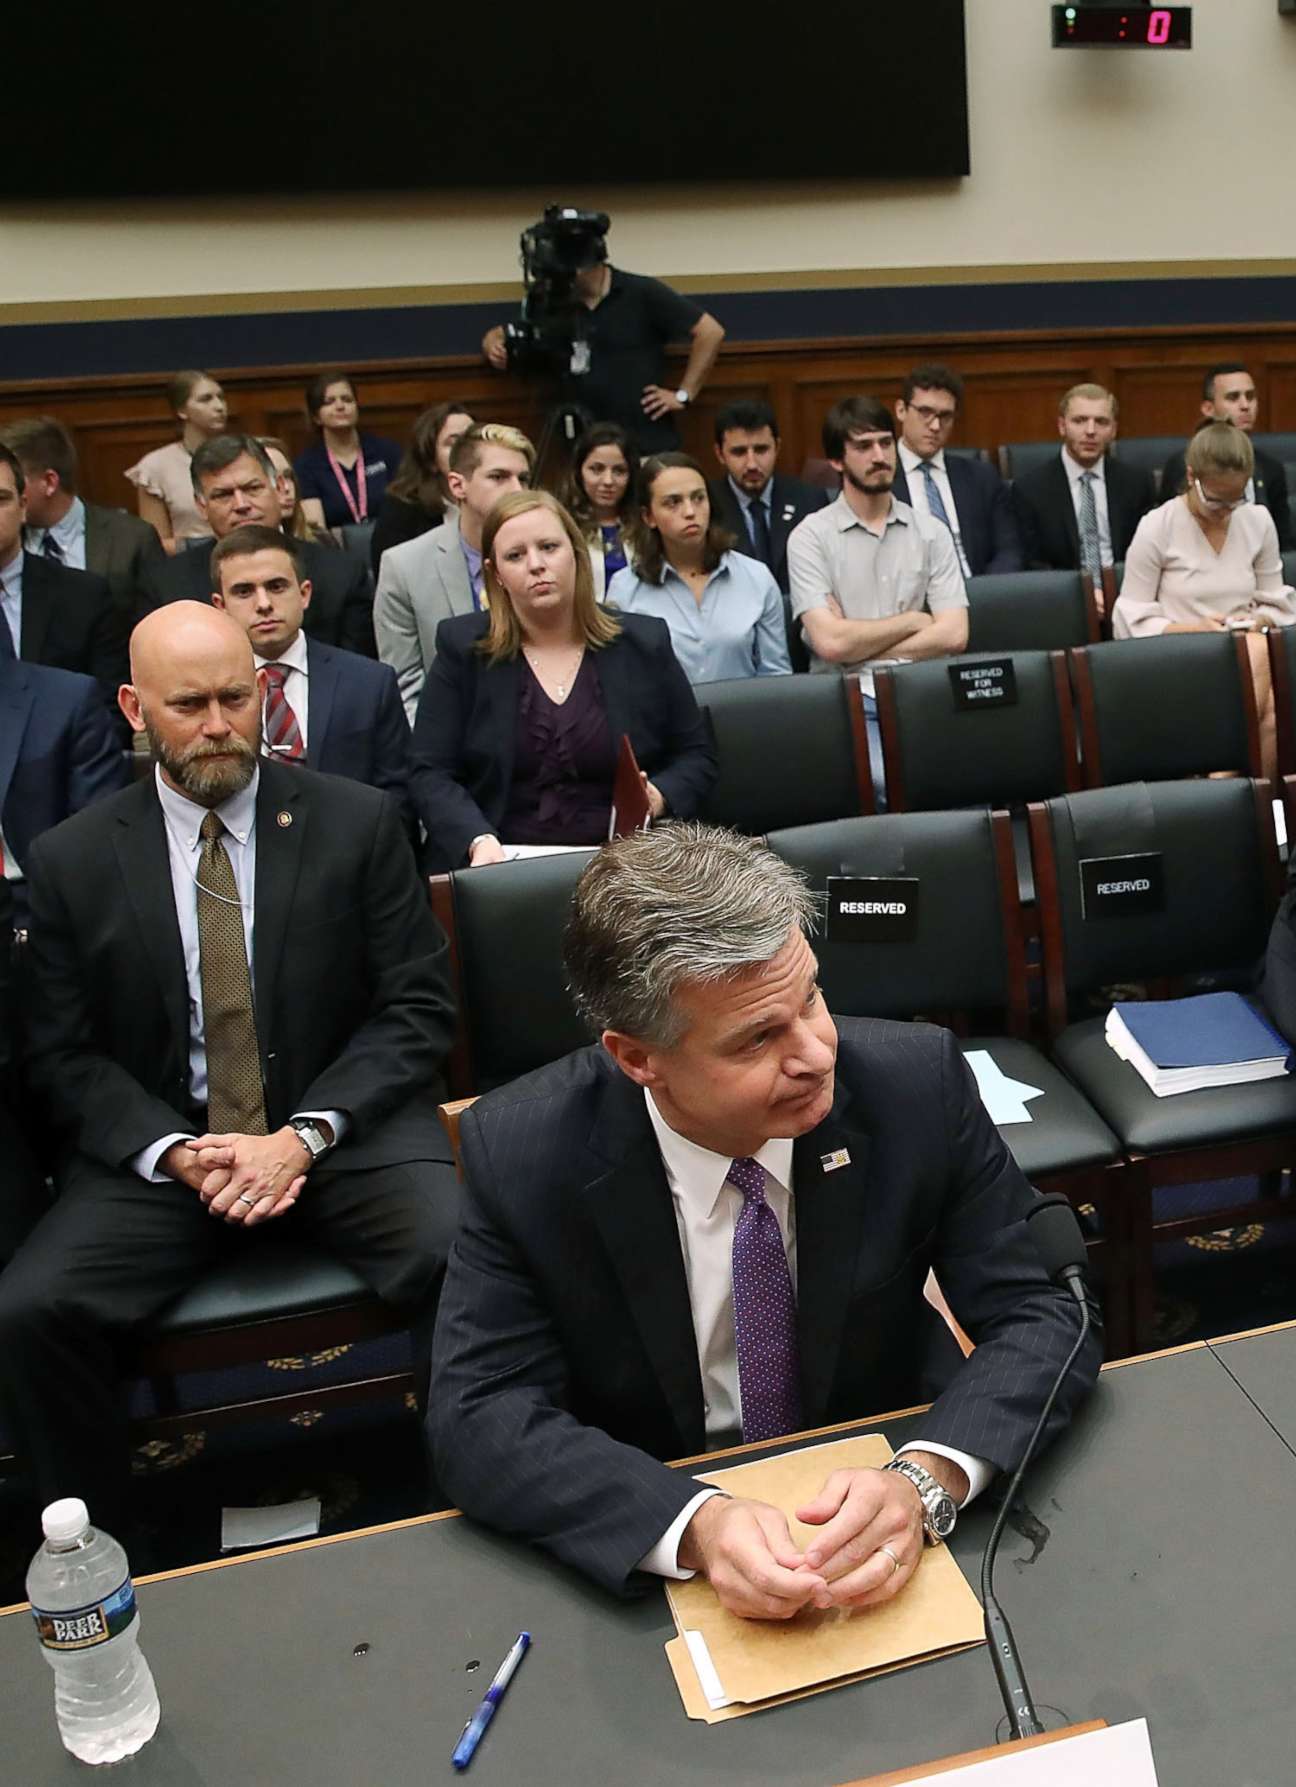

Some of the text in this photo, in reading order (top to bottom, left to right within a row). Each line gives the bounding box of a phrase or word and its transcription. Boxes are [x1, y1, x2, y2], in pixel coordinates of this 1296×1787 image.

[960, 667, 1004, 680] RESERVED
[974, 679, 992, 688] FOR
[1097, 879, 1150, 895] RESERVED
[840, 902, 906, 914] RESERVED
[53, 1612, 101, 1632] DEER
[56, 1626, 102, 1641] PARK
